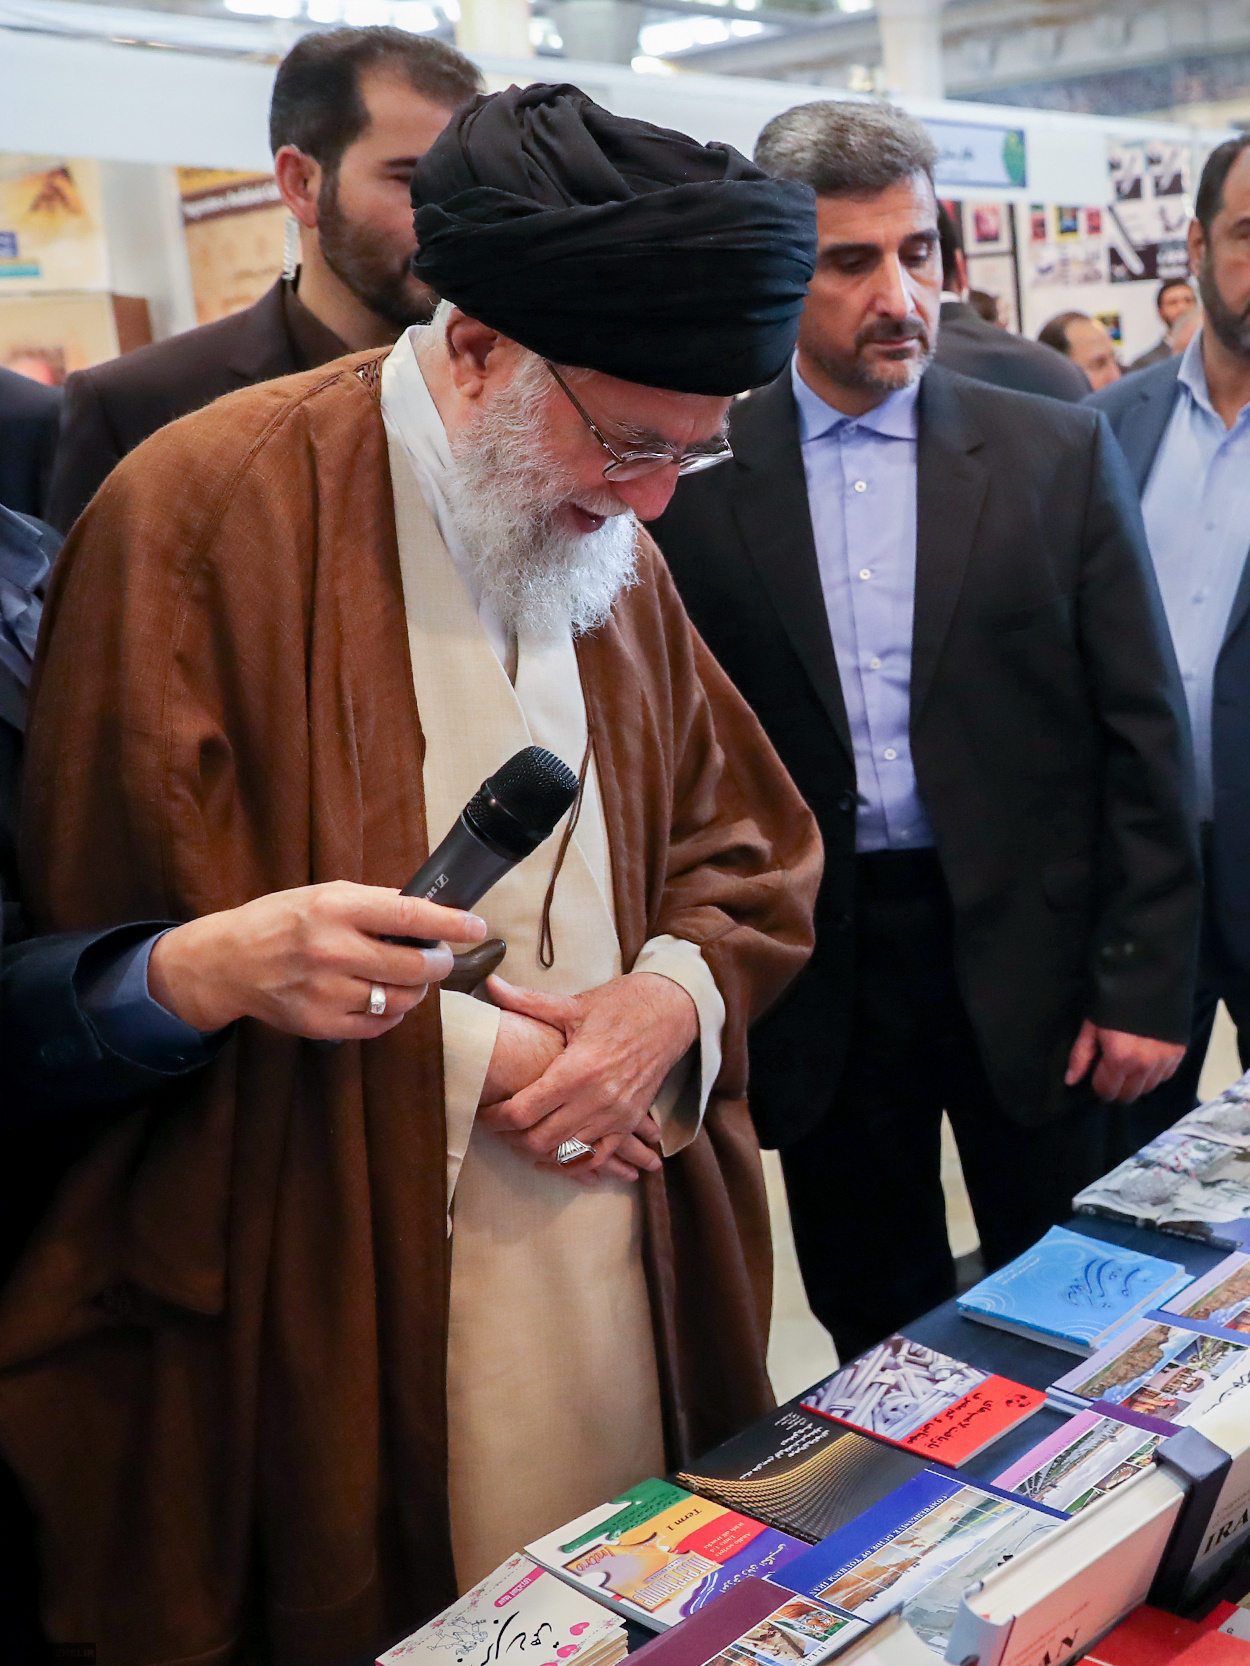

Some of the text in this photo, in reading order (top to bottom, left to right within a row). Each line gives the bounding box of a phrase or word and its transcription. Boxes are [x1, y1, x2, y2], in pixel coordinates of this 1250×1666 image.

[665, 1507, 702, 1532] Term 1
[703, 1535, 723, 1549] tracks
[715, 1531, 751, 1558] Audio scripts
[718, 1534, 736, 1547] Units
[807, 1493, 949, 1597] COMPREHENSIVE GUIDE OF TOURISM IRAN
[575, 1546, 616, 1573] Intro
[740, 1564, 759, 1577] زبان
[758, 1543, 787, 1567] انگلیسی
